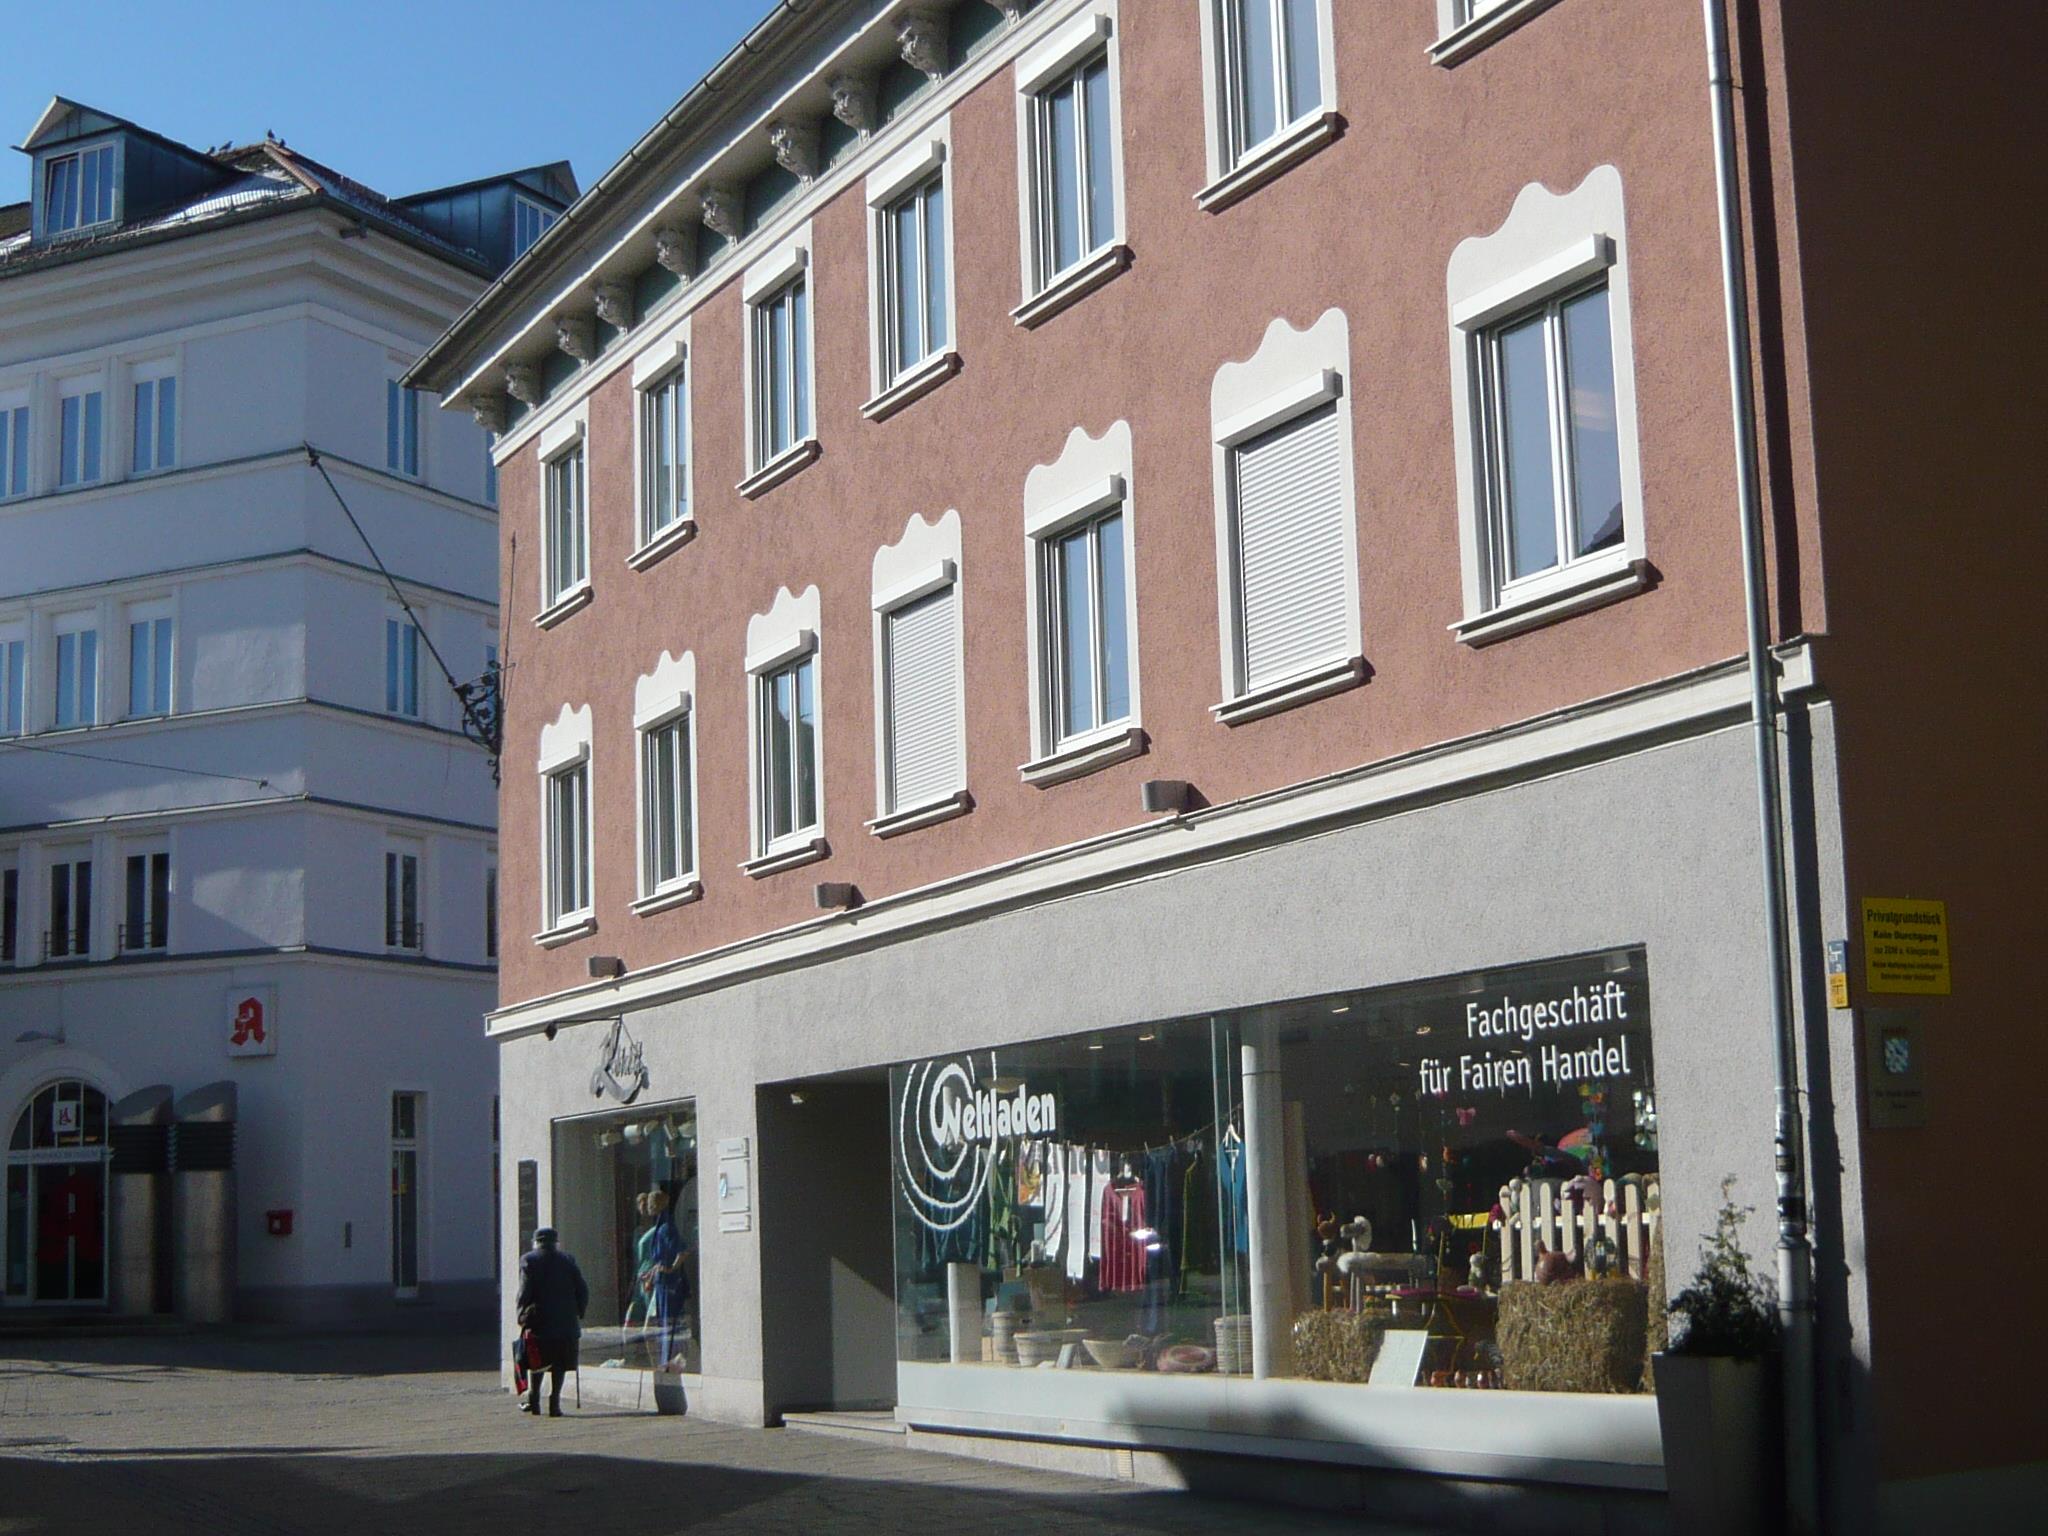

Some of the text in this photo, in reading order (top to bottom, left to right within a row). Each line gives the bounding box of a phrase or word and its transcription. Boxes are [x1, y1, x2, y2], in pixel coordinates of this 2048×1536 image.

[1466, 980, 1628, 1042] Fachgeschäft
[1418, 1034, 1631, 1095] für Fairen Handel
[930, 1083, 1057, 1146] Weltladen
